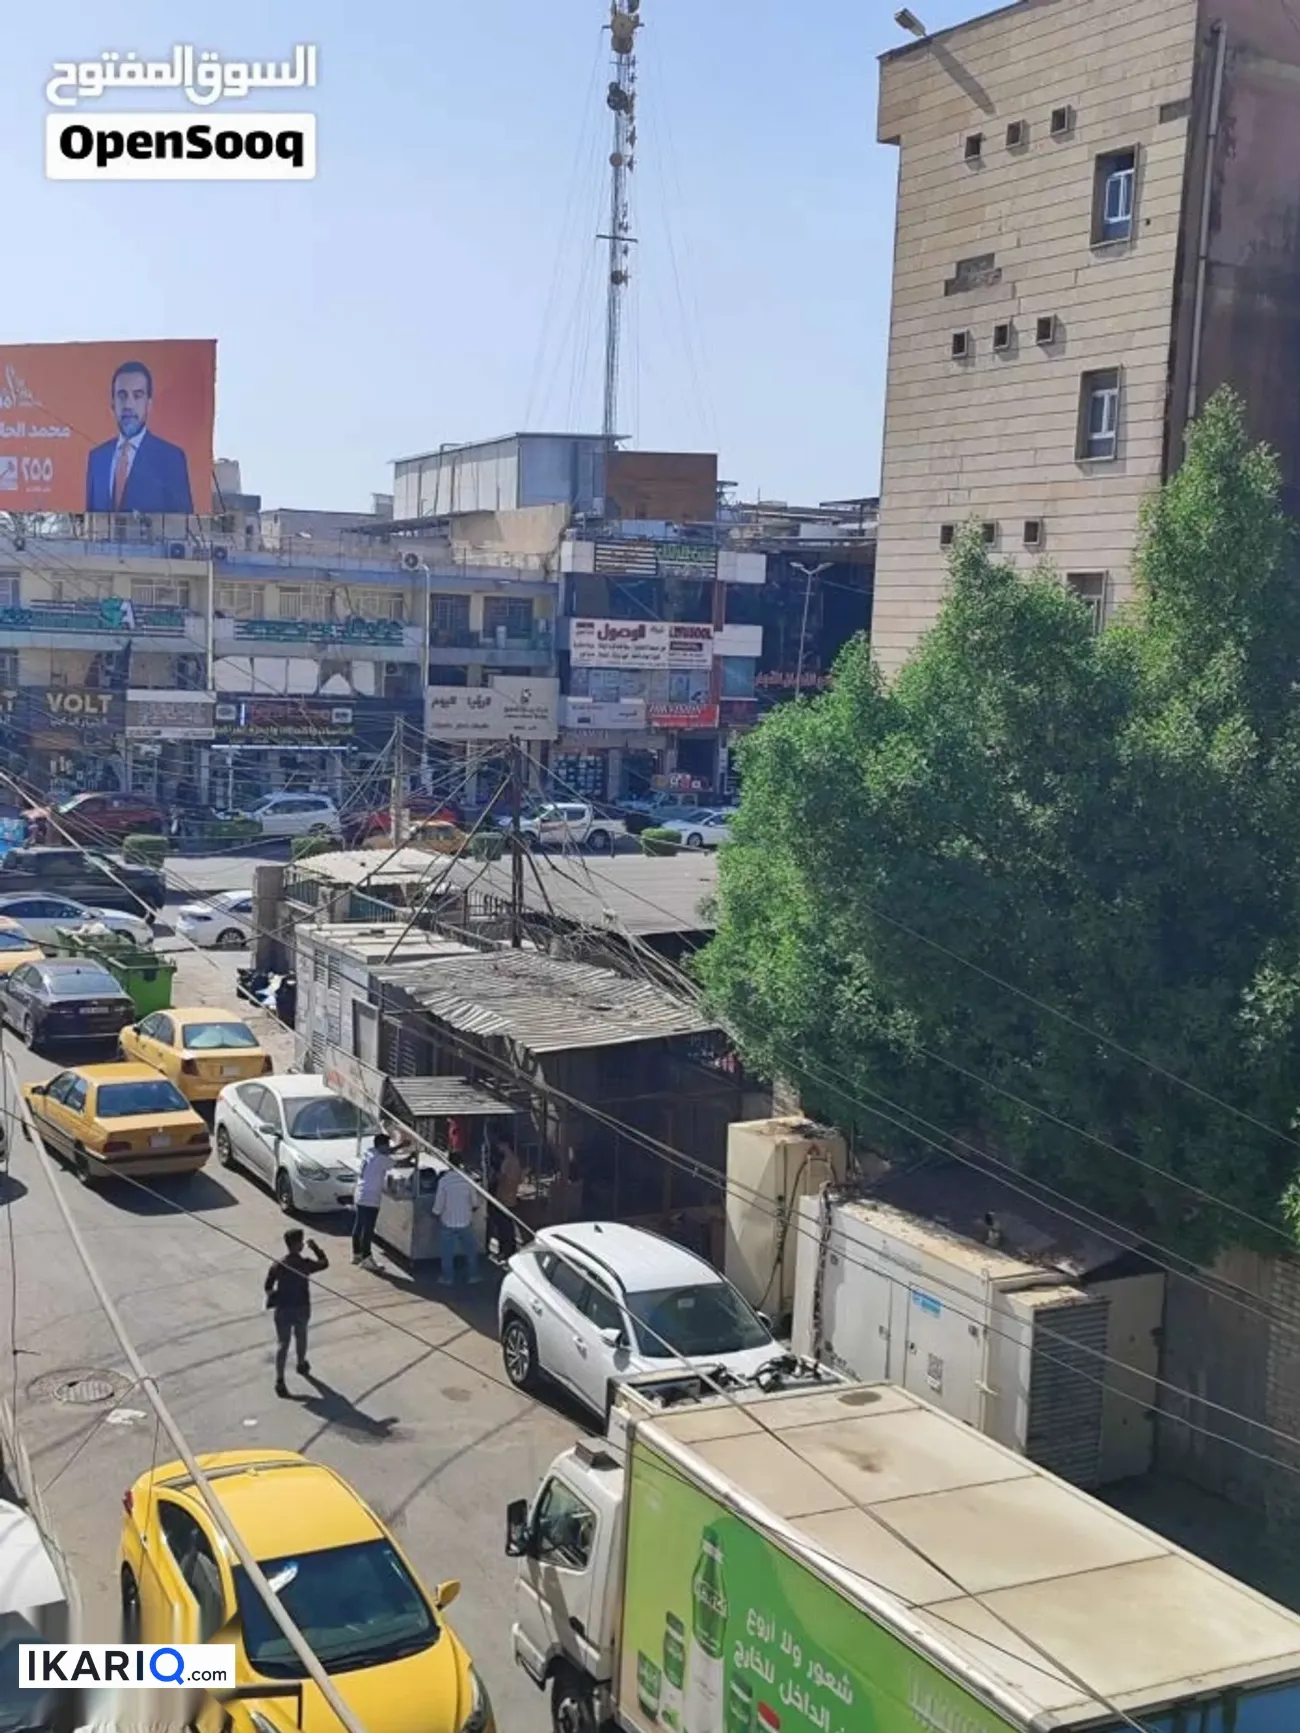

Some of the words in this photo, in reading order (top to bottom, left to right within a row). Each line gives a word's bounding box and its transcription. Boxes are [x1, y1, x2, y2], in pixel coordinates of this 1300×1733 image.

[46, 692, 113, 714] VOLT
[733, 1640, 776, 1684] للخارج
[806, 1659, 853, 1705] شعور
[778, 1679, 831, 1733] الداخل
